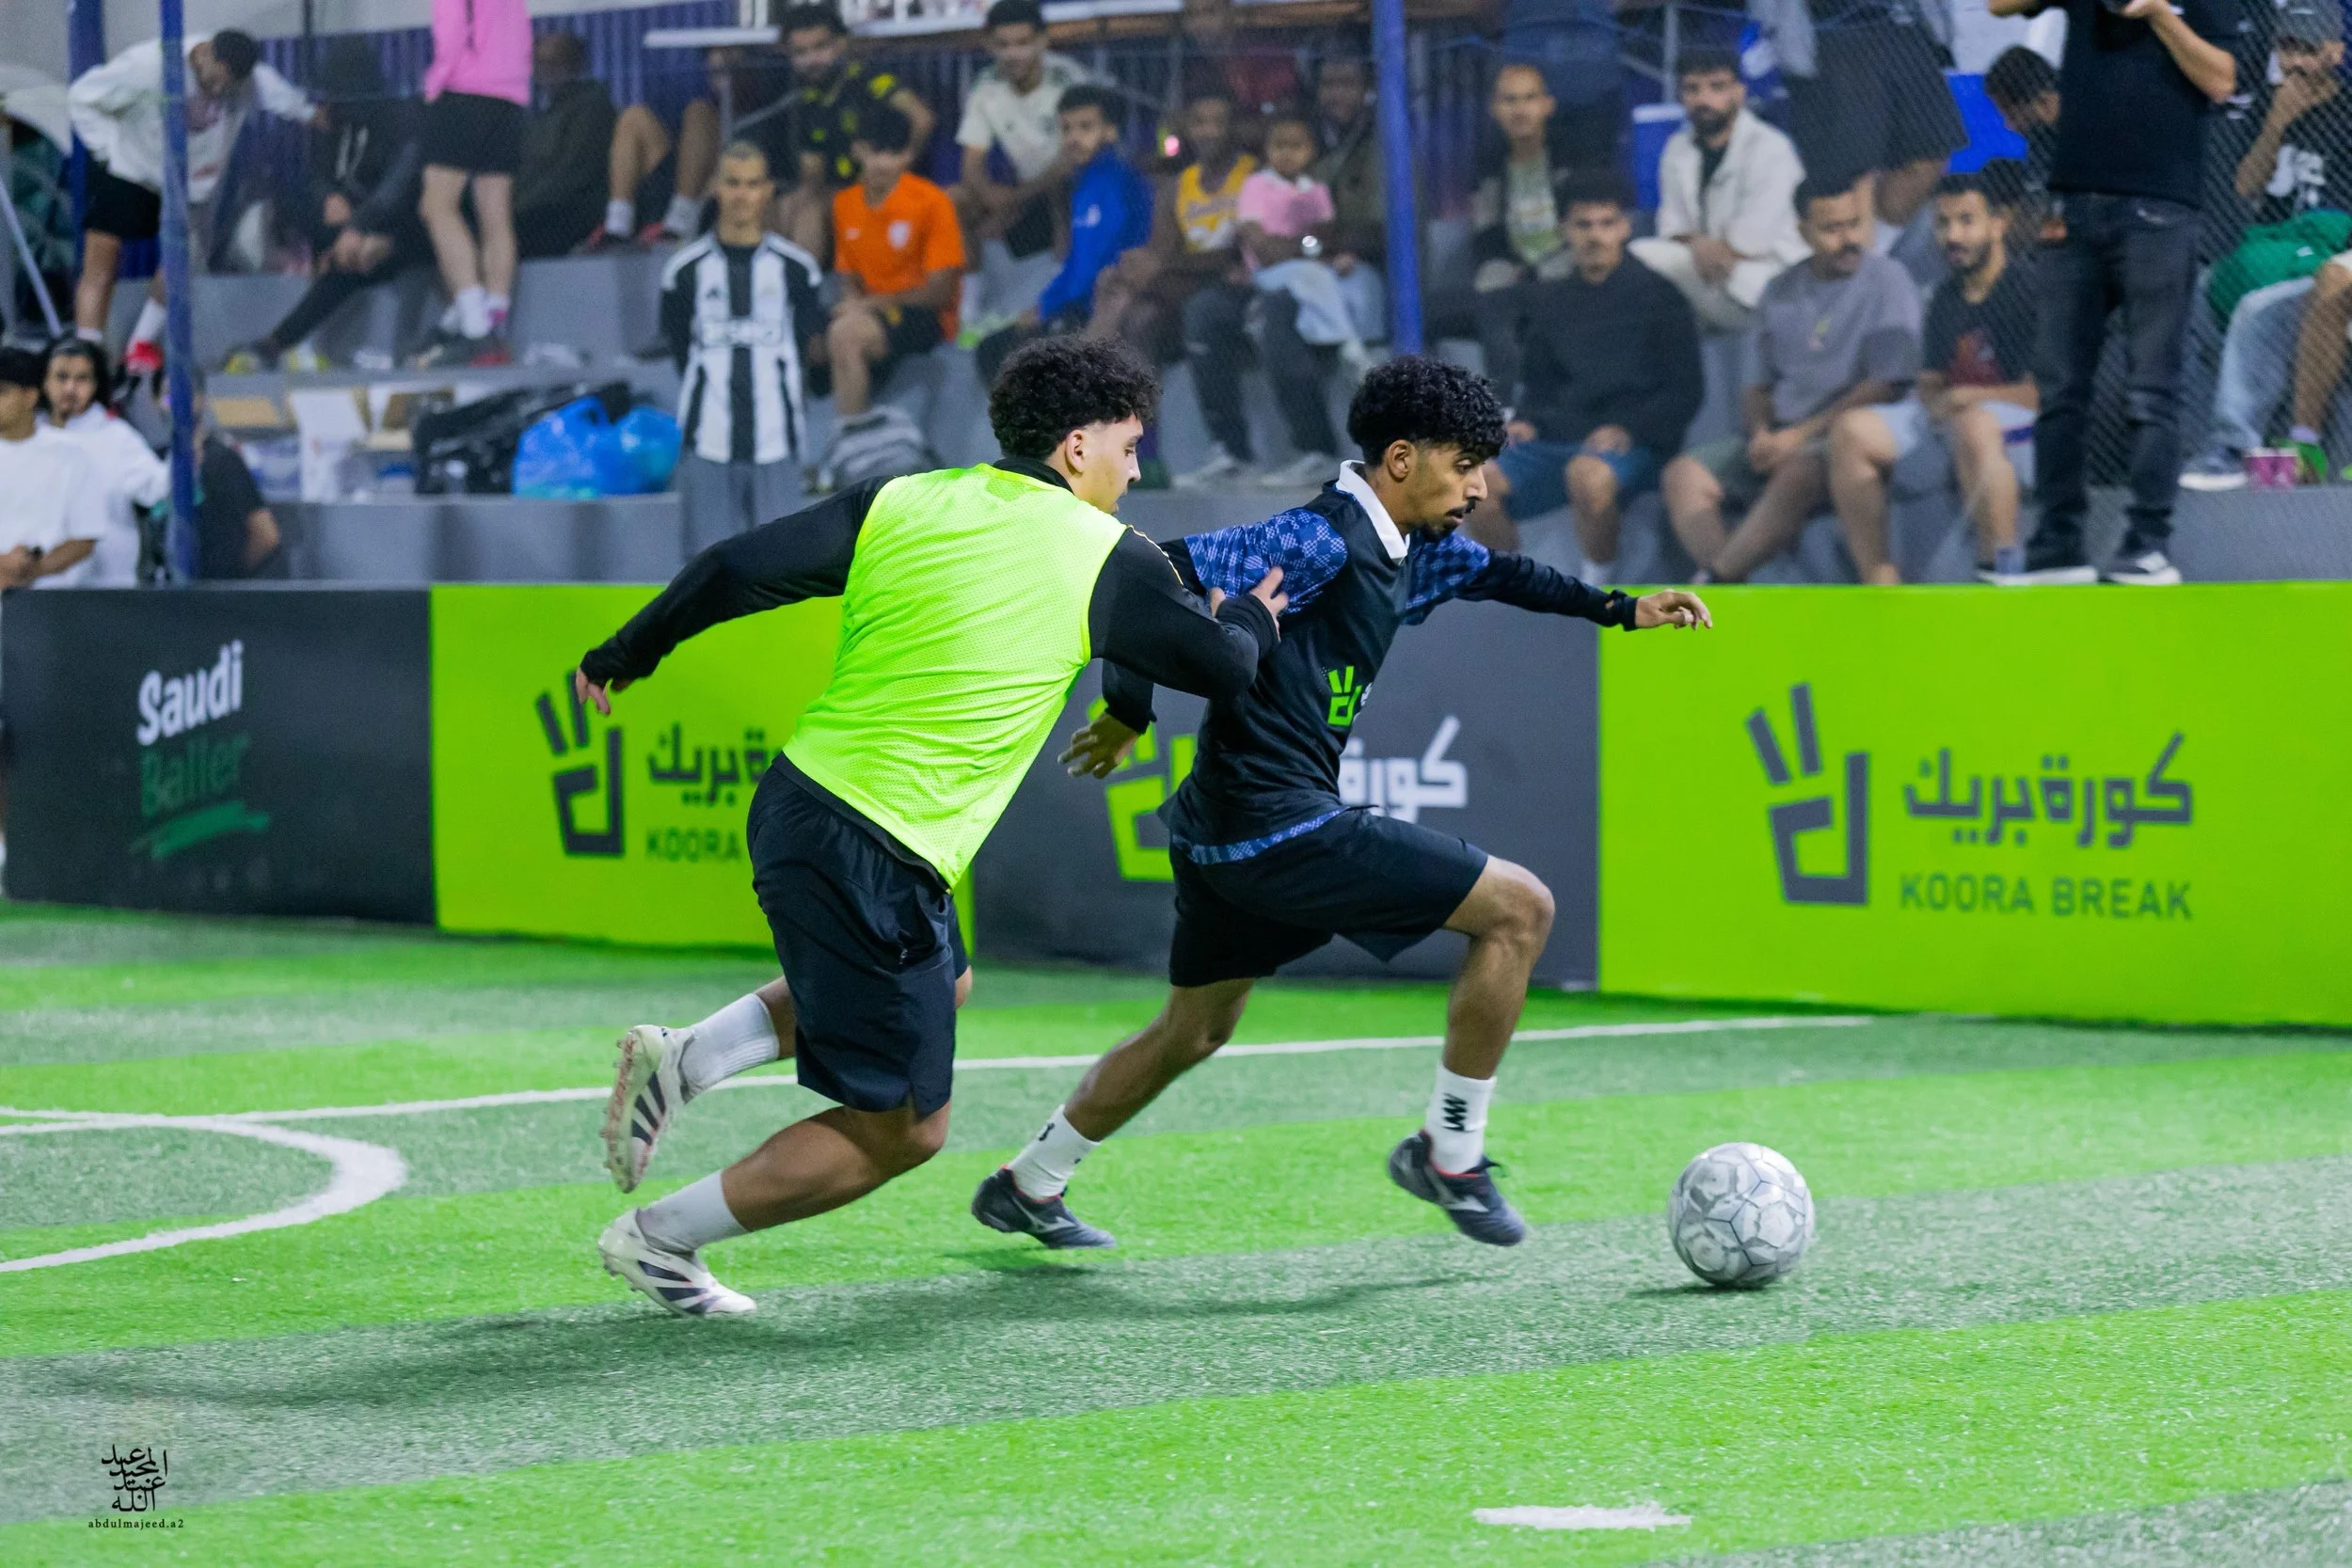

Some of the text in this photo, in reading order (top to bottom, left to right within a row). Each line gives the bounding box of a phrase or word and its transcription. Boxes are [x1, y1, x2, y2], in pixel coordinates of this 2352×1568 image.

[136, 639, 245, 746] Saudi
[140, 732, 251, 817] Baller
[645, 828, 741, 863] KOORA
[1899, 872, 2194, 920] KOORA BREAK
